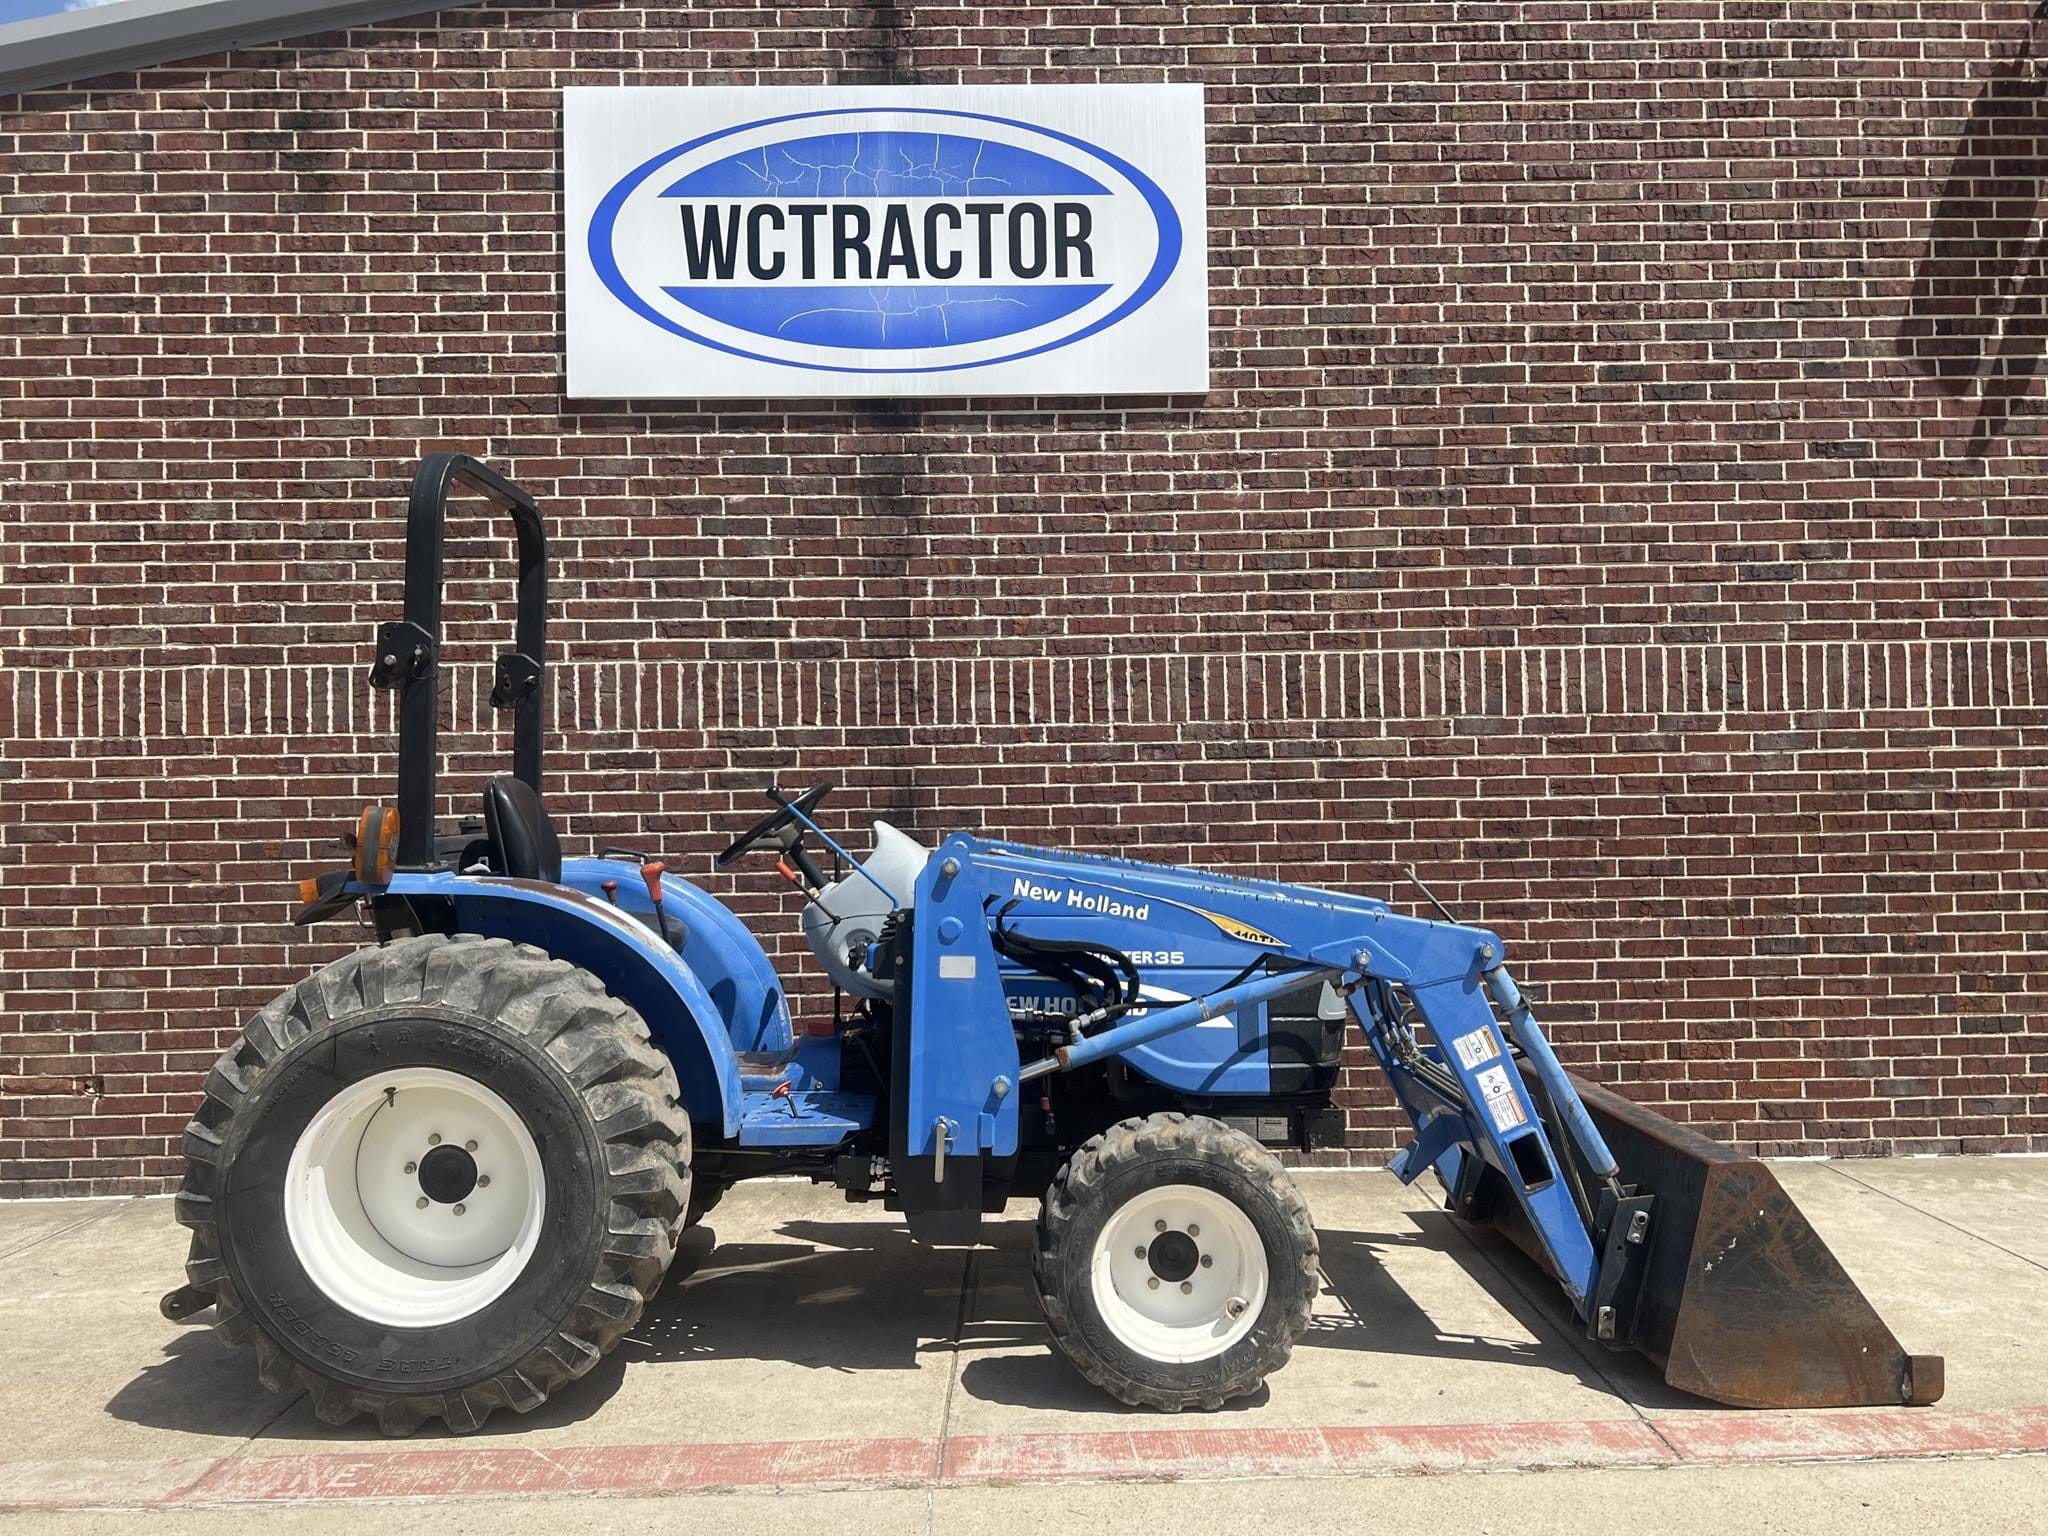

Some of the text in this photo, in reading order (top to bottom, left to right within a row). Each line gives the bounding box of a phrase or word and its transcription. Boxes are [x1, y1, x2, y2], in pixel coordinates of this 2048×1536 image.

[680, 202, 1095, 281] WCTRACTOR
[1012, 877, 1150, 922] New Holland
[1006, 996, 1038, 1013] EW
